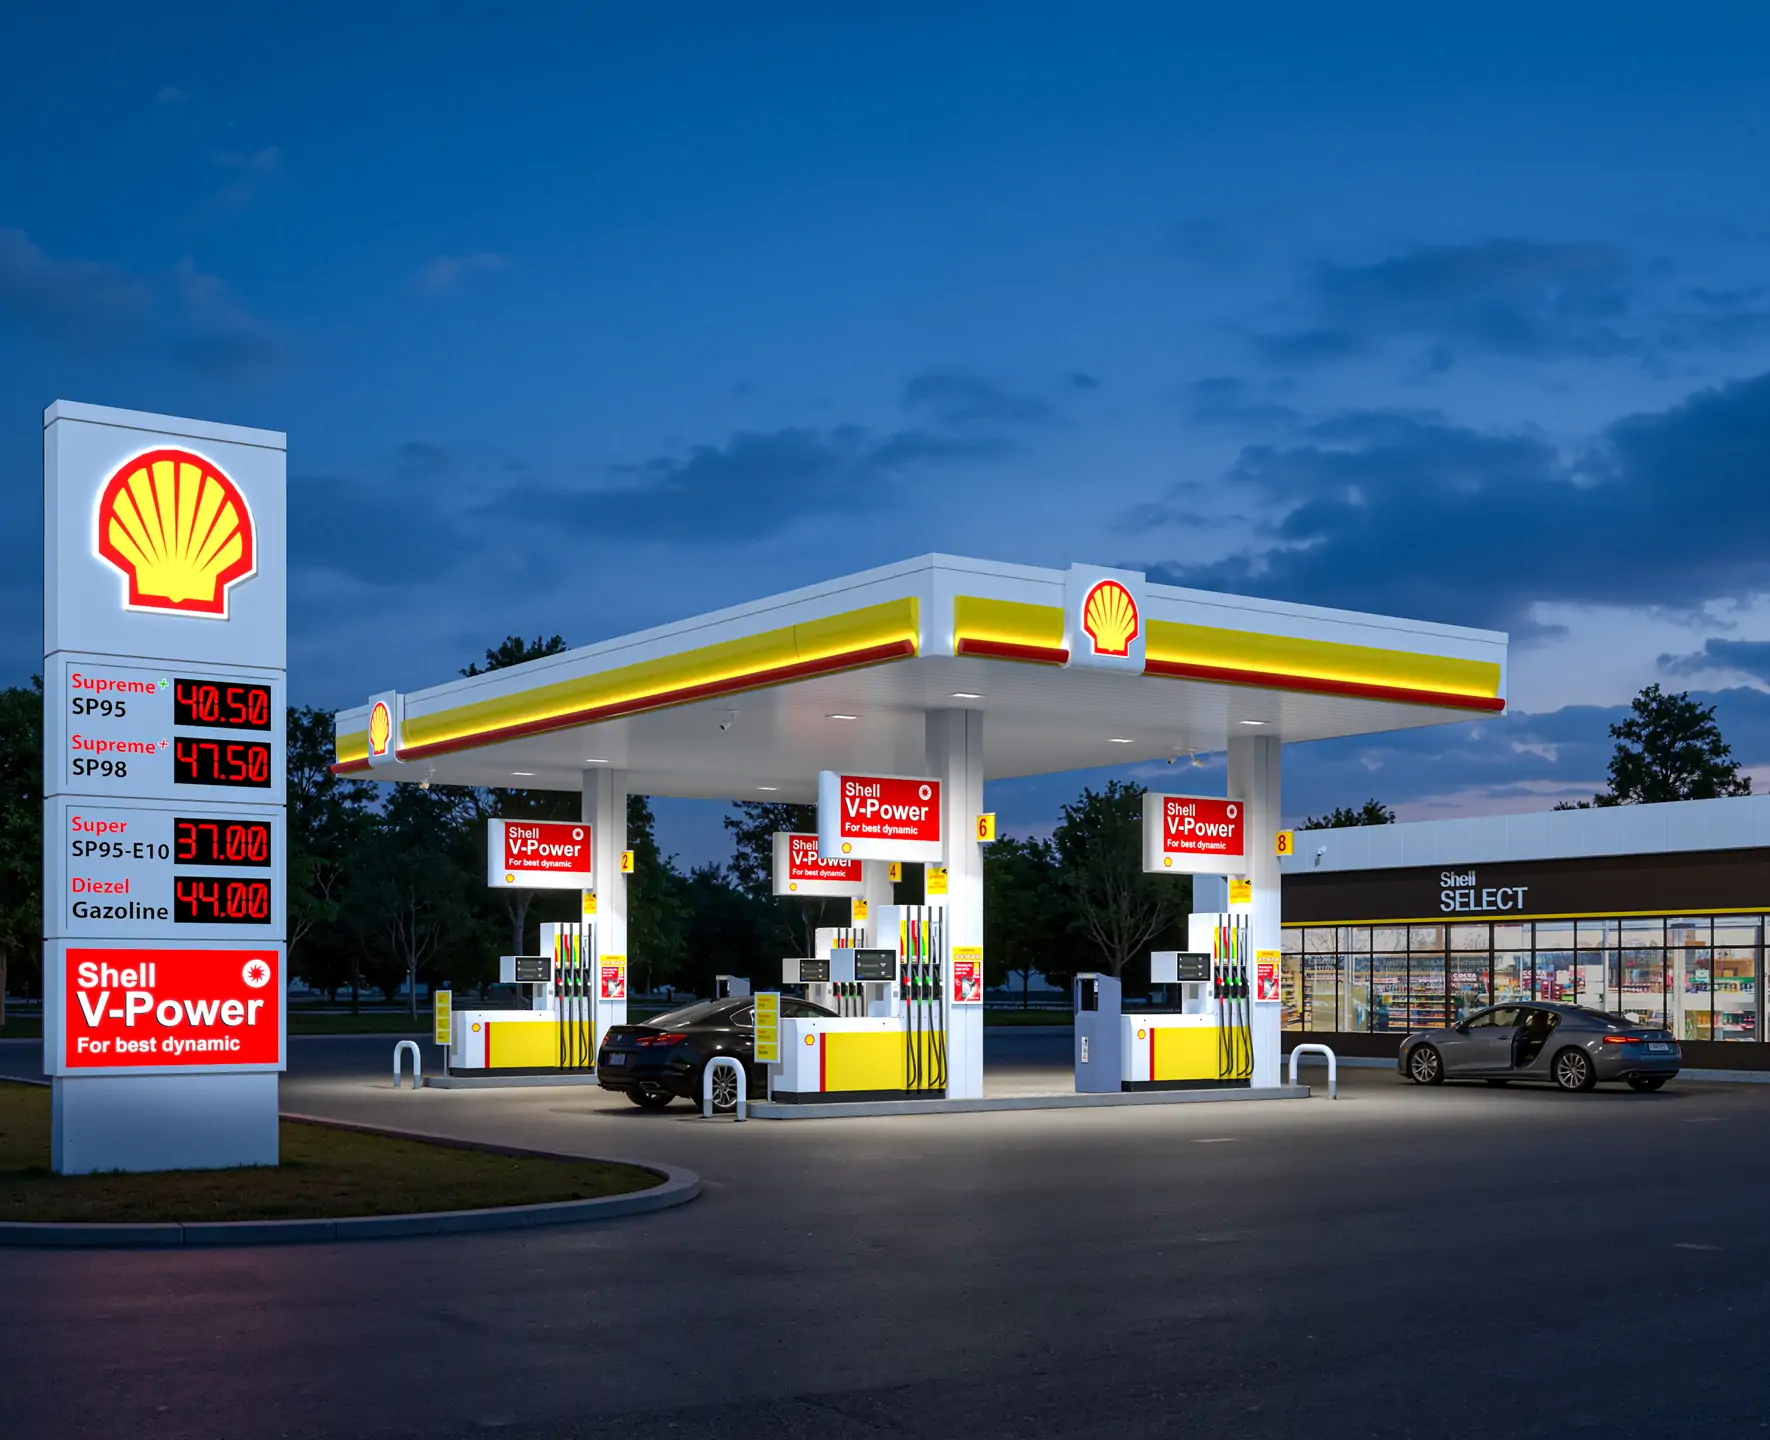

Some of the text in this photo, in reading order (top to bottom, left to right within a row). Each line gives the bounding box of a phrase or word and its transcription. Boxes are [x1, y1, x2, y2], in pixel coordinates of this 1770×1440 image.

[71, 697, 127, 717] SP95
[176, 683, 268, 724] 40.50
[71, 758, 128, 778] SP98
[176, 742, 268, 782] 47.50
[845, 781, 880, 798] Shell
[845, 798, 929, 821] V-Power
[1167, 802, 1196, 816] Shell
[71, 816, 128, 836] Super
[508, 826, 540, 839] Shell
[845, 822, 919, 836] For best dynamic
[978, 818, 988, 837] 6
[1167, 816, 1235, 837] V-Power
[71, 840, 170, 860] SP95-E10
[177, 822, 268, 862] 37.00
[508, 839, 582, 857] V-Power
[792, 839, 819, 850] Shell
[1167, 838, 1227, 850] For best dynamic
[1277, 834, 1287, 852] 8
[508, 858, 573, 869] For best dynamic
[622, 854, 628, 869] 2
[792, 868, 846, 878] For best dynamic
[889, 864, 897, 879] 4
[1440, 870, 1476, 887] Shell
[71, 877, 130, 894] Diezel
[176, 880, 268, 918] 44.00
[1440, 886, 1529, 912] SELECT
[72, 902, 169, 920] Gazoline
[77, 961, 156, 989] Shell
[76, 990, 265, 1028] V-Power
[77, 1035, 241, 1056] For best dynamic
